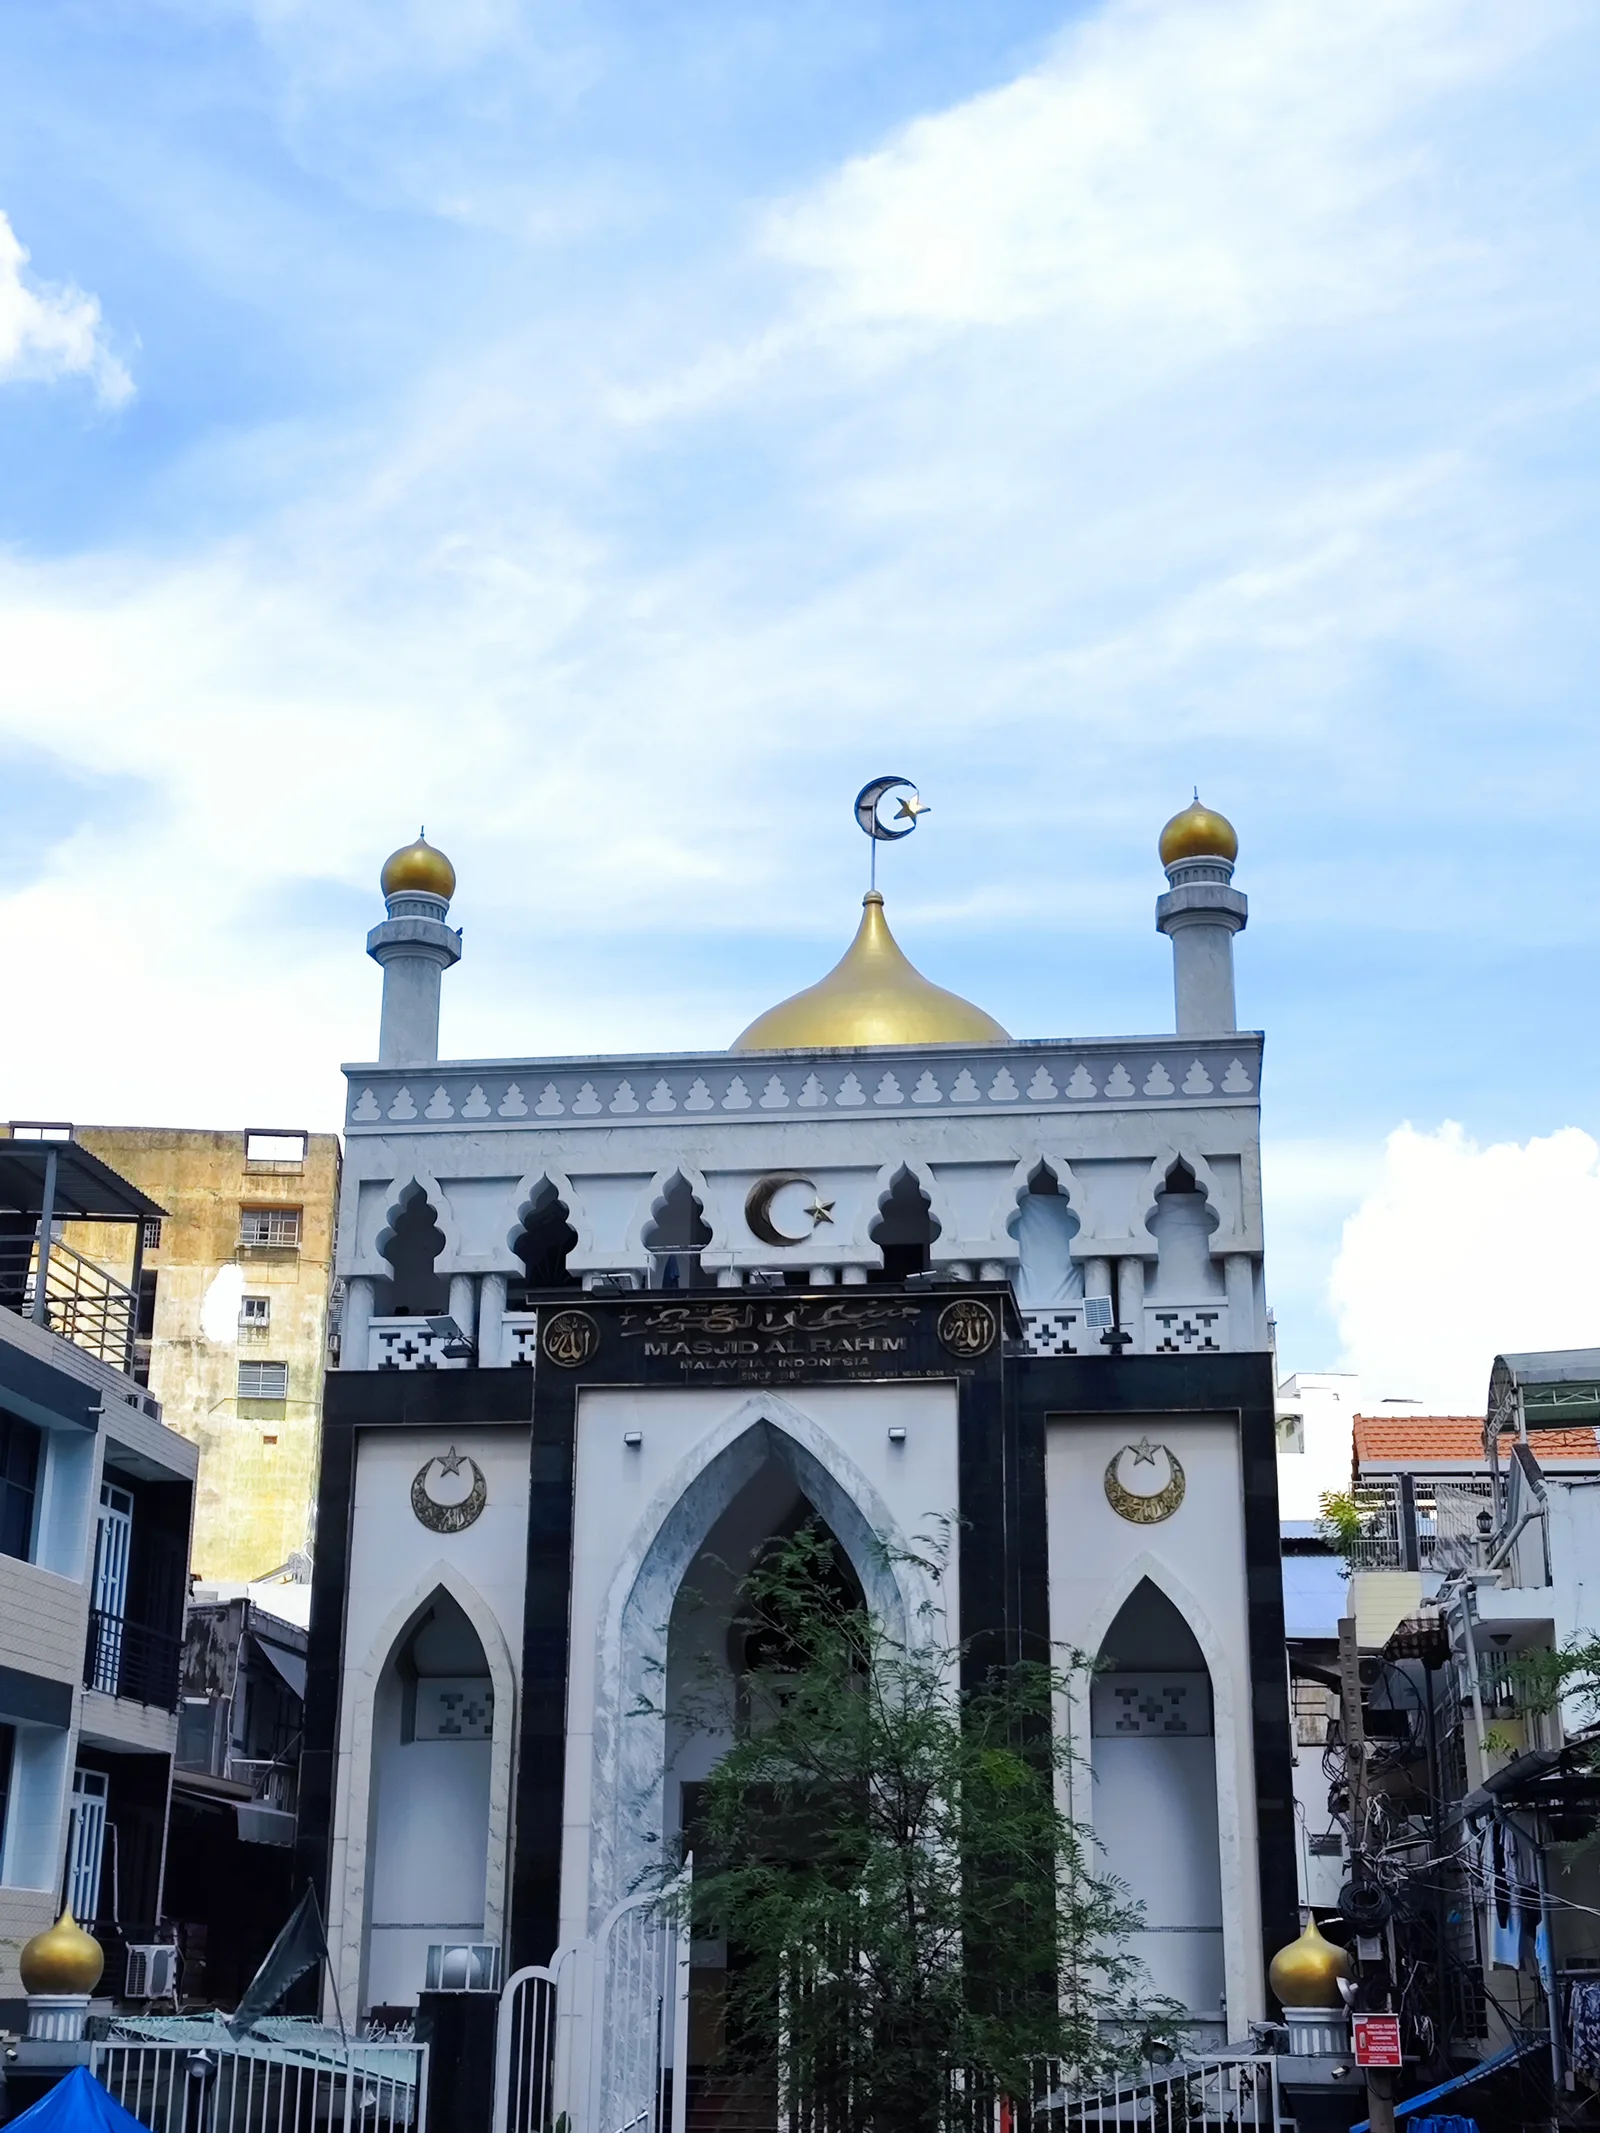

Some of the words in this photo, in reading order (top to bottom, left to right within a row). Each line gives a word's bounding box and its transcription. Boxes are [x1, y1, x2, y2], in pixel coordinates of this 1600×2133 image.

[644, 1340, 759, 1356] MASJID
[765, 1339, 804, 1354] AL
[809, 1337, 907, 1352] RAHIM
[680, 1358, 765, 1369] MALAYSIA
[778, 1356, 870, 1367] INDONESIA
[741, 1372, 771, 1380] SINCE
